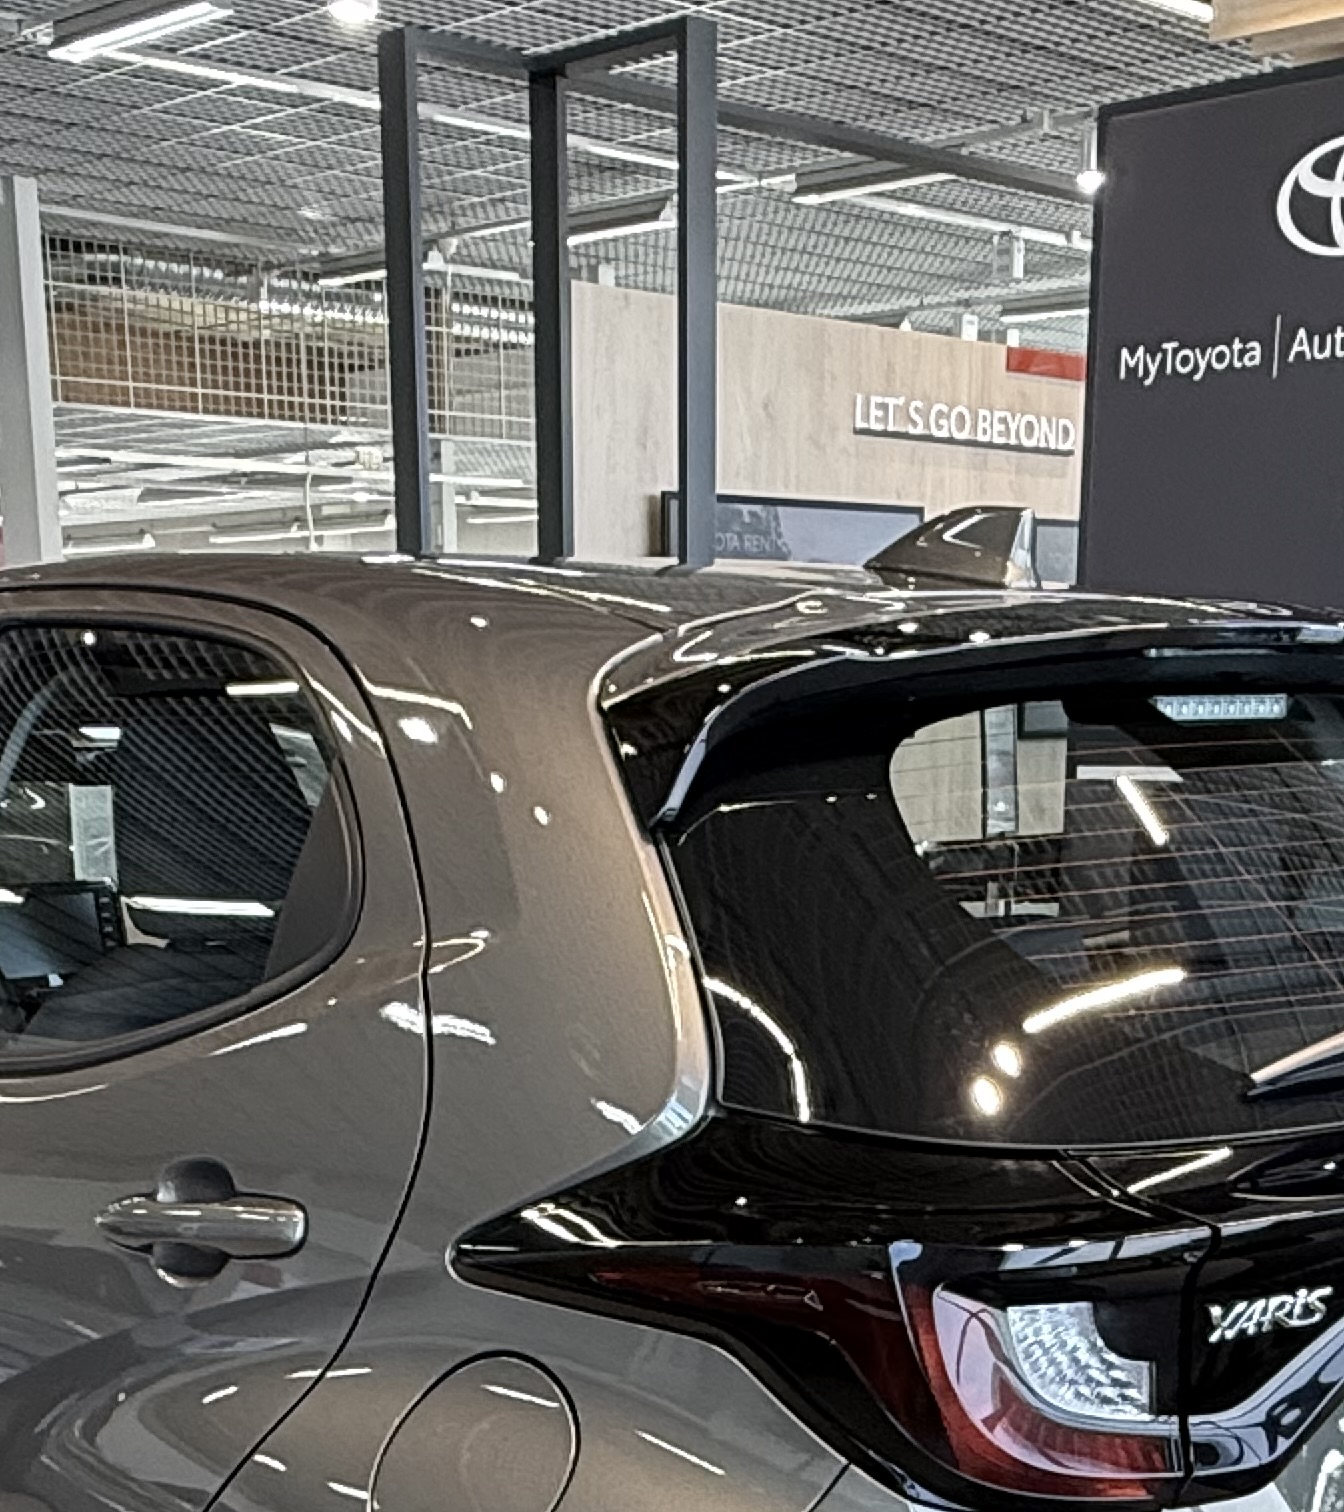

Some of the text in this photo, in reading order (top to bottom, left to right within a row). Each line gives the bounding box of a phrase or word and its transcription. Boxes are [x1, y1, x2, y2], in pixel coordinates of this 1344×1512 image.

[1119, 337, 1262, 386] MyToyota
[929, 403, 971, 439] GO
[1208, 1286, 1334, 1343] YARIS
